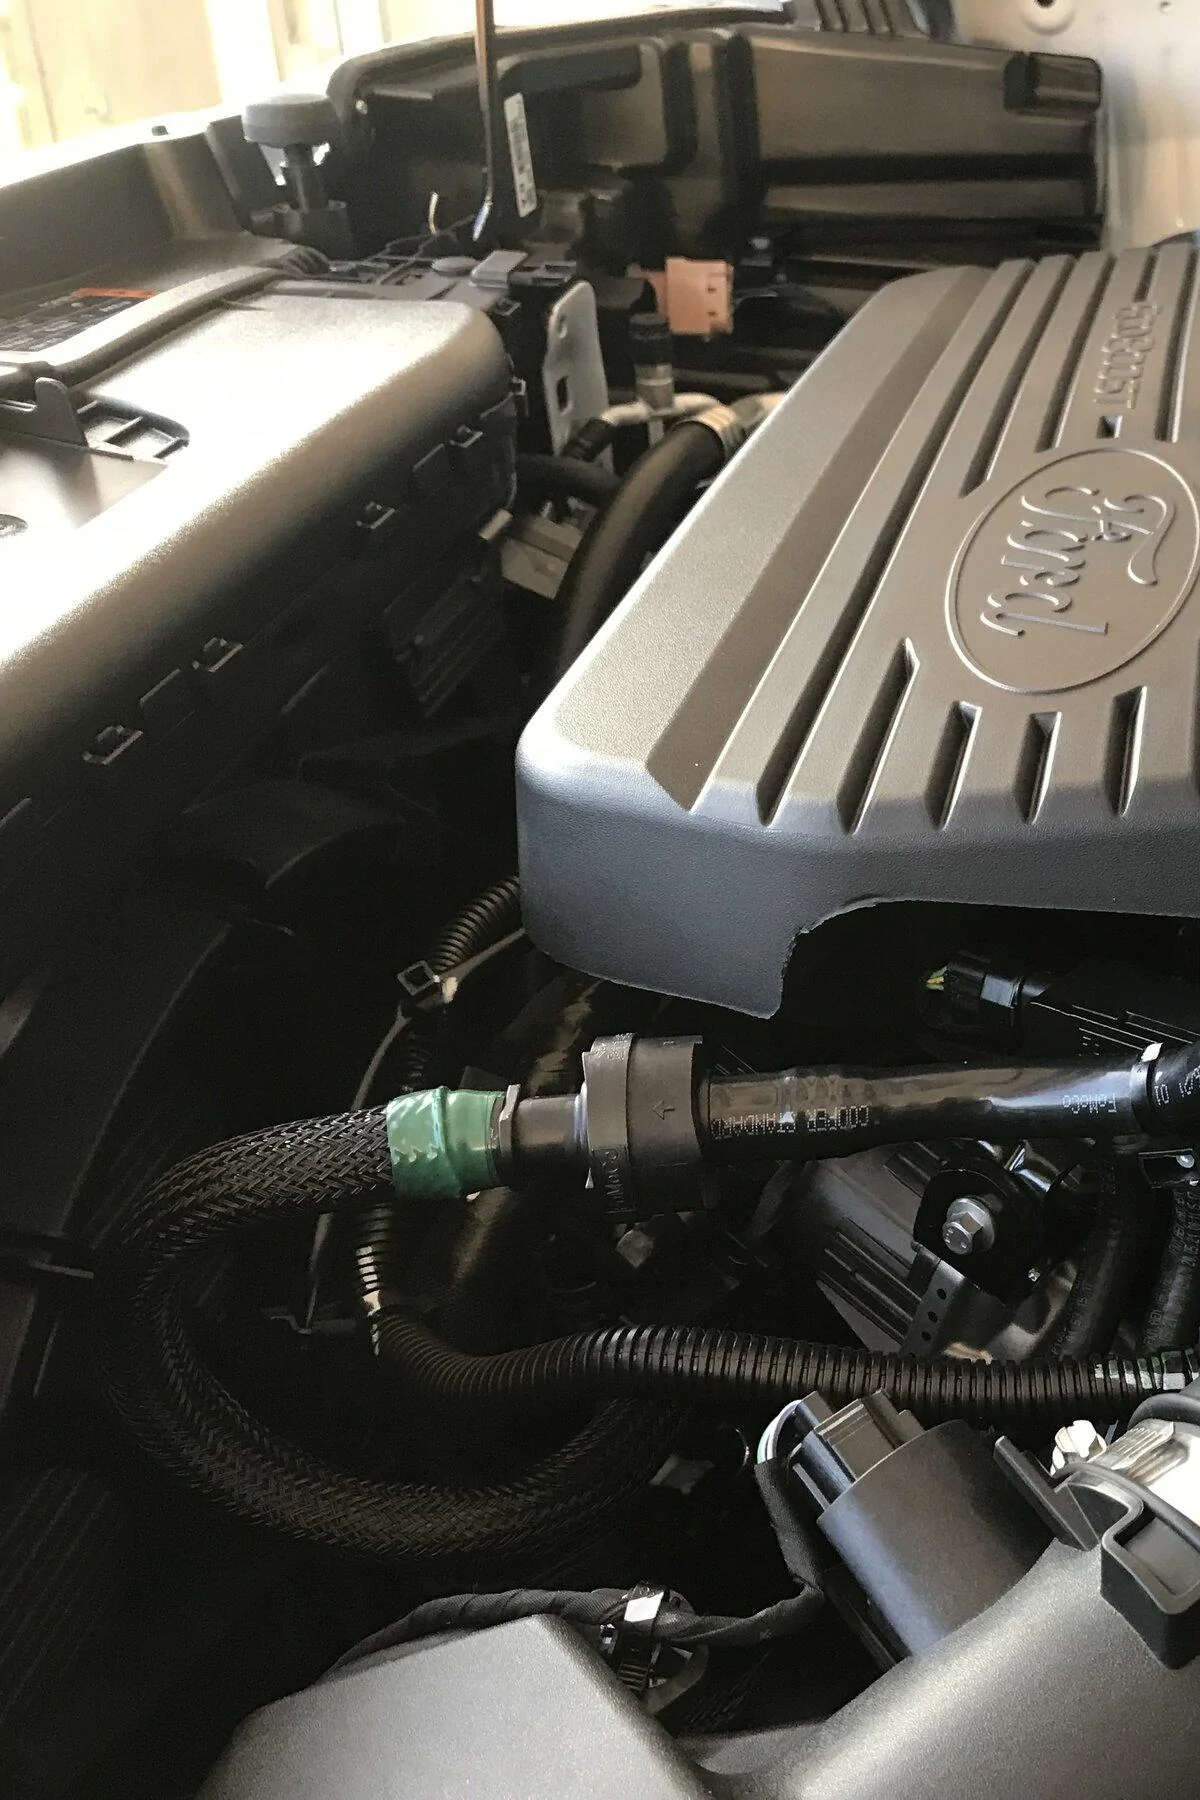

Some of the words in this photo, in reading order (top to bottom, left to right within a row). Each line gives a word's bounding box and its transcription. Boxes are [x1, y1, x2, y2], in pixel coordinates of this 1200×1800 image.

[980, 486, 1174, 638] Ford
[1062, 1093, 1118, 1114] FoMoCo
[806, 1104, 870, 1133] COOPER
